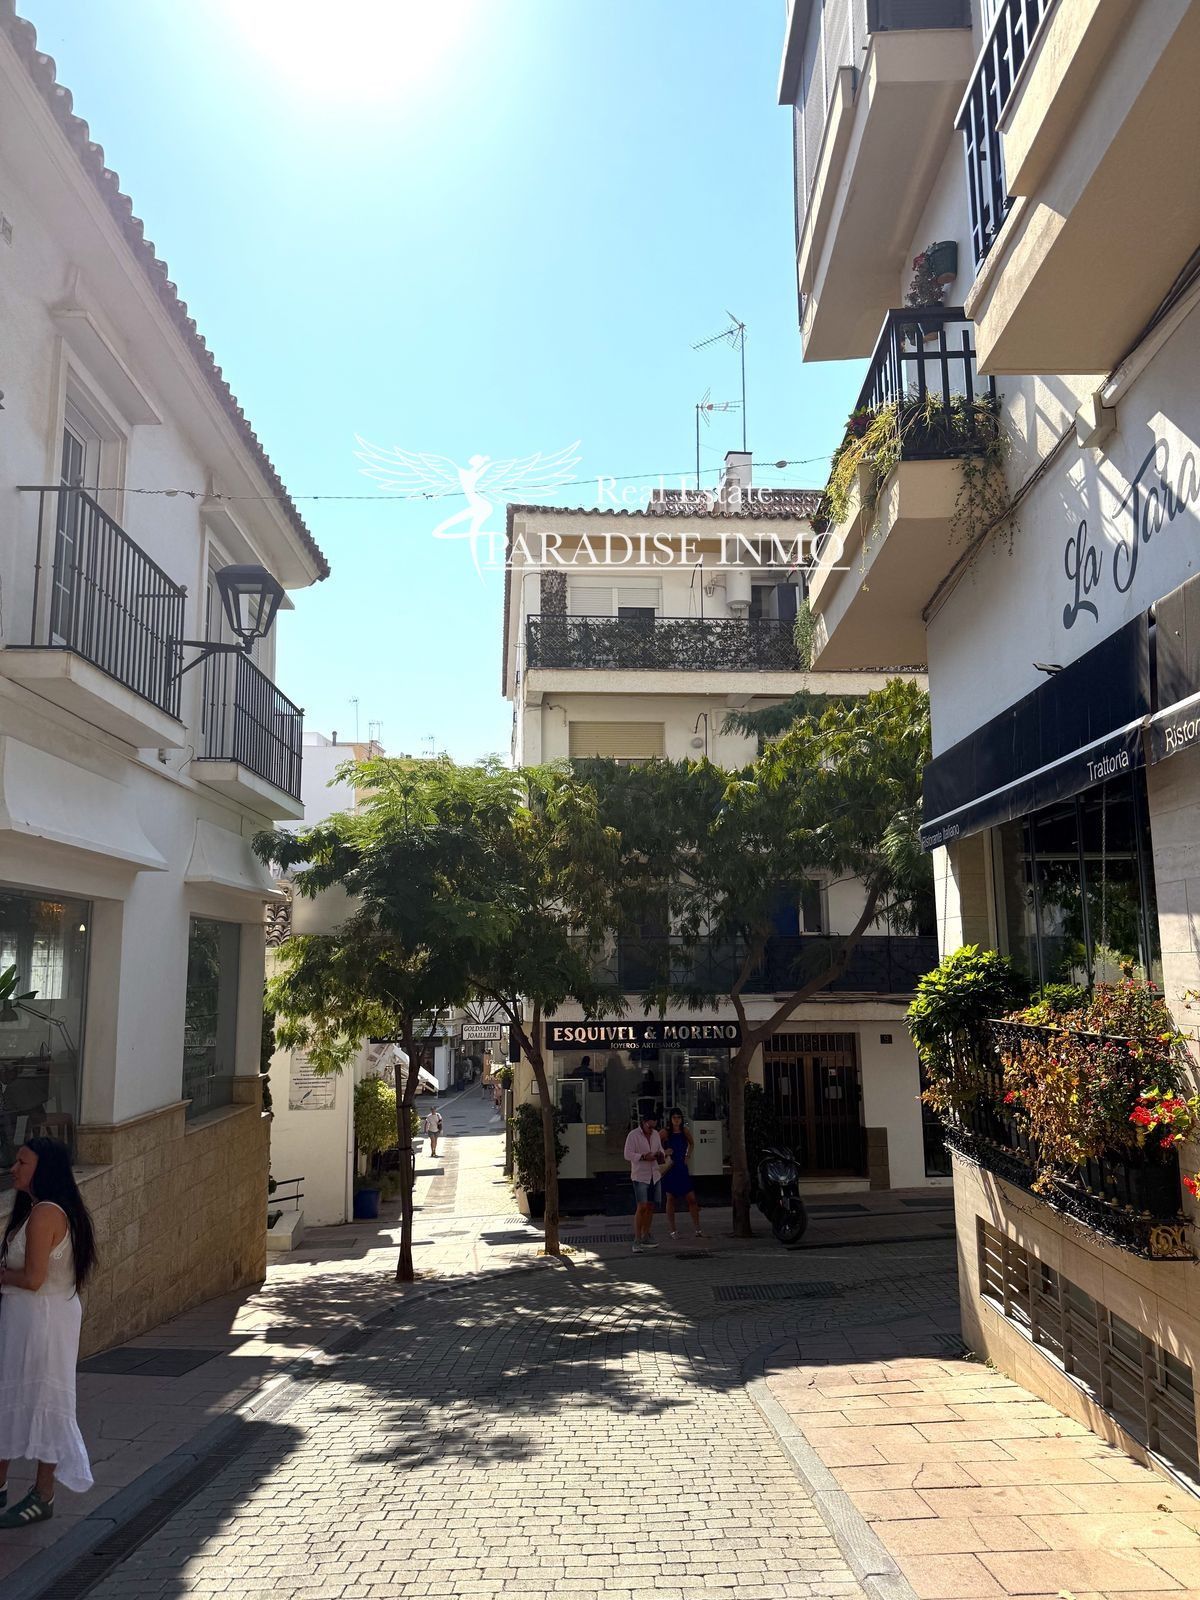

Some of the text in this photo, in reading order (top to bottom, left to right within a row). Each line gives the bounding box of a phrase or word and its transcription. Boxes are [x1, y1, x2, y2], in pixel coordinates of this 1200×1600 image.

[1062, 519, 1103, 630] La
[1086, 748, 1130, 782] Trattoria
[943, 824, 960, 839] Italiano
[552, 1025, 738, 1043] ESQUIVEL & MORENO
